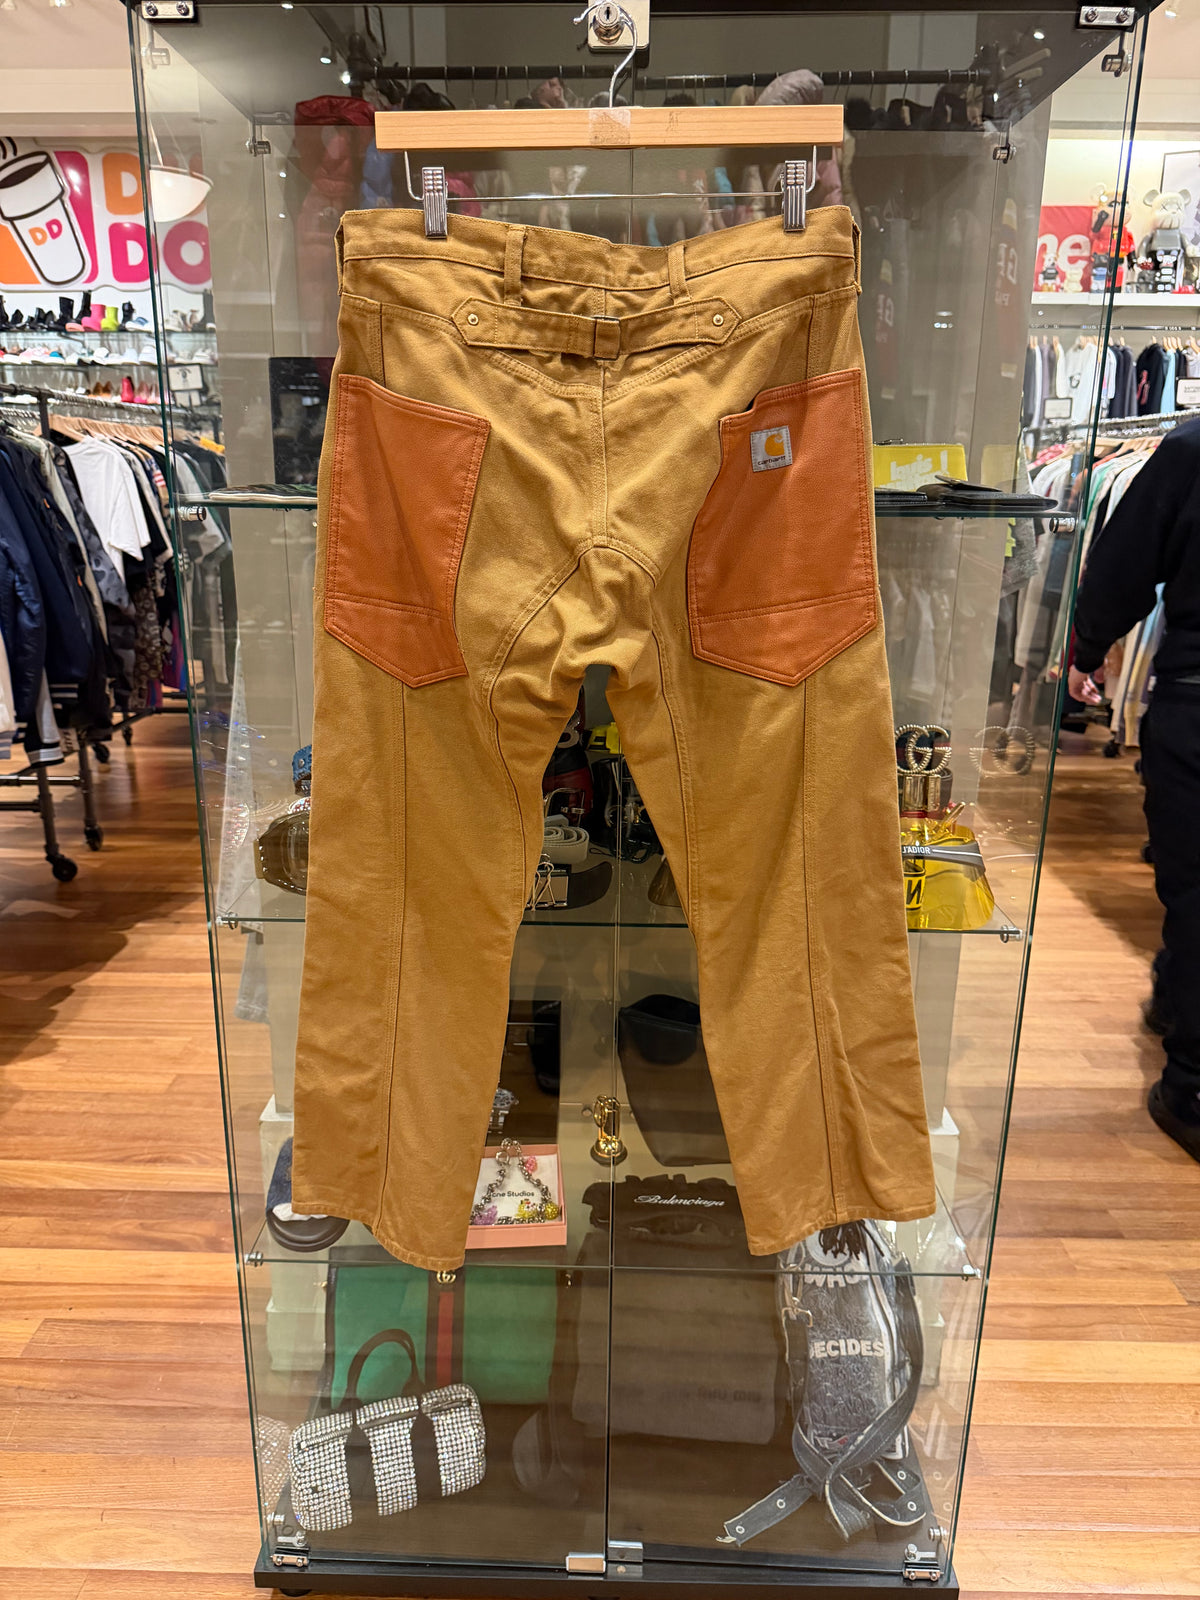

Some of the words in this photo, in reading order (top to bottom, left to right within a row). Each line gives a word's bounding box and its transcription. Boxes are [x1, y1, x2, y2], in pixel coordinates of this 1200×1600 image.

[757, 455, 786, 466] carhartt
[490, 1190, 506, 1198] cne
[507, 1190, 535, 1198] Studios
[634, 1194, 725, 1208] Balenciaga
